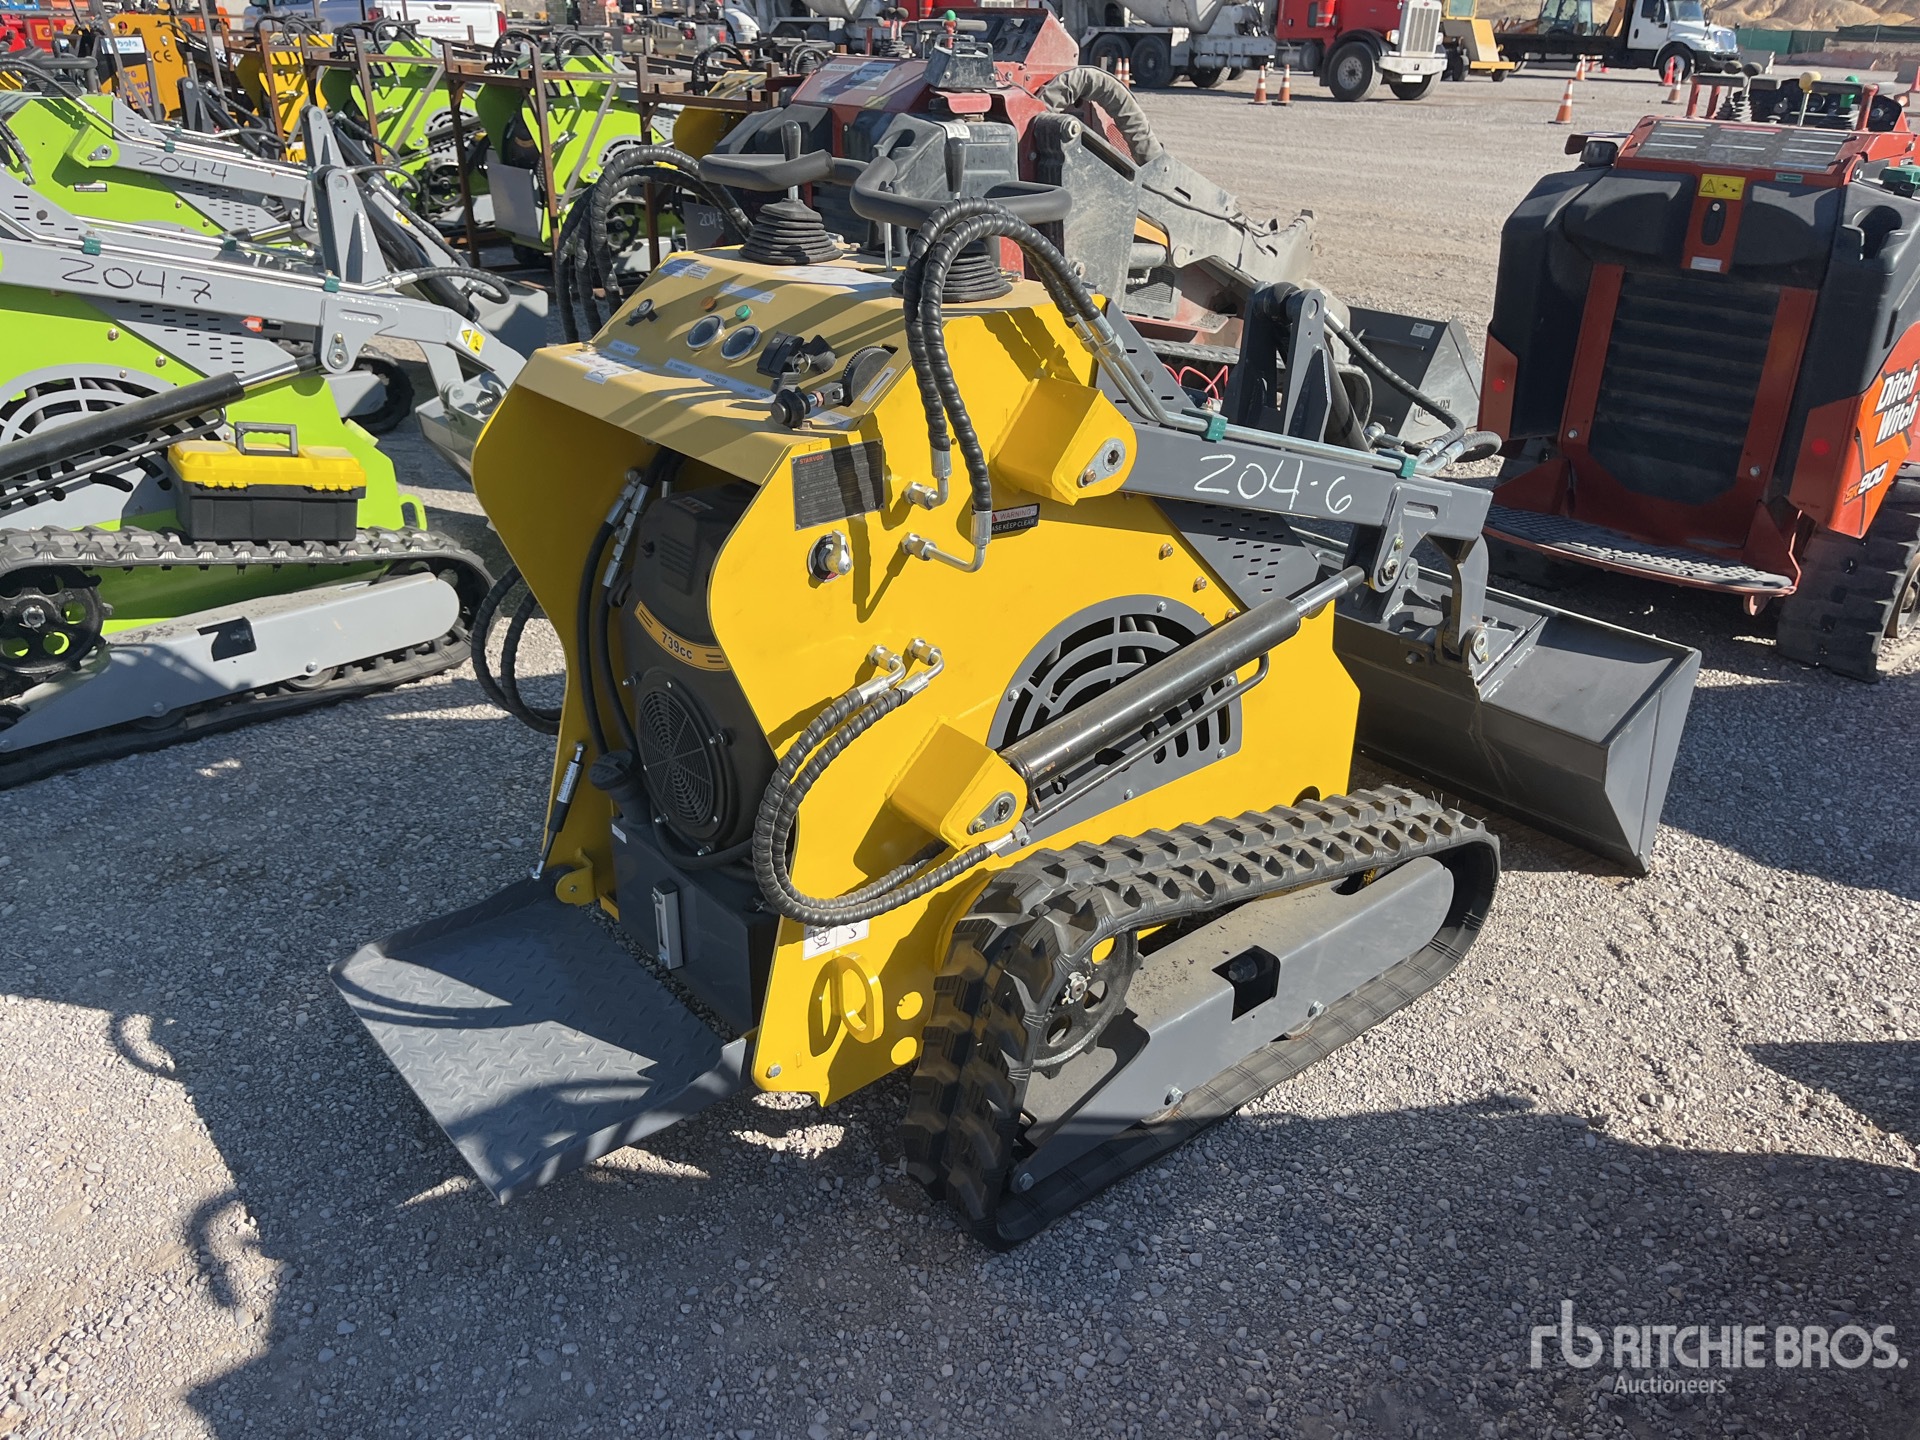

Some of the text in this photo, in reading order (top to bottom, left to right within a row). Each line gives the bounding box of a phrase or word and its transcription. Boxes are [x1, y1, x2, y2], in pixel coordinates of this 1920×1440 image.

[138, 151, 228, 183] 204-4
[59, 257, 212, 304] 204-7
[1875, 362, 1919, 413] Ditch
[1875, 394, 1919, 444] Witch
[799, 454, 825, 464] STARVOX
[1193, 453, 1353, 515] 204-6
[1003, 521, 1017, 530] KEEP
[1017, 518, 1035, 528] CLEAR
[661, 631, 693, 660] 739cc
